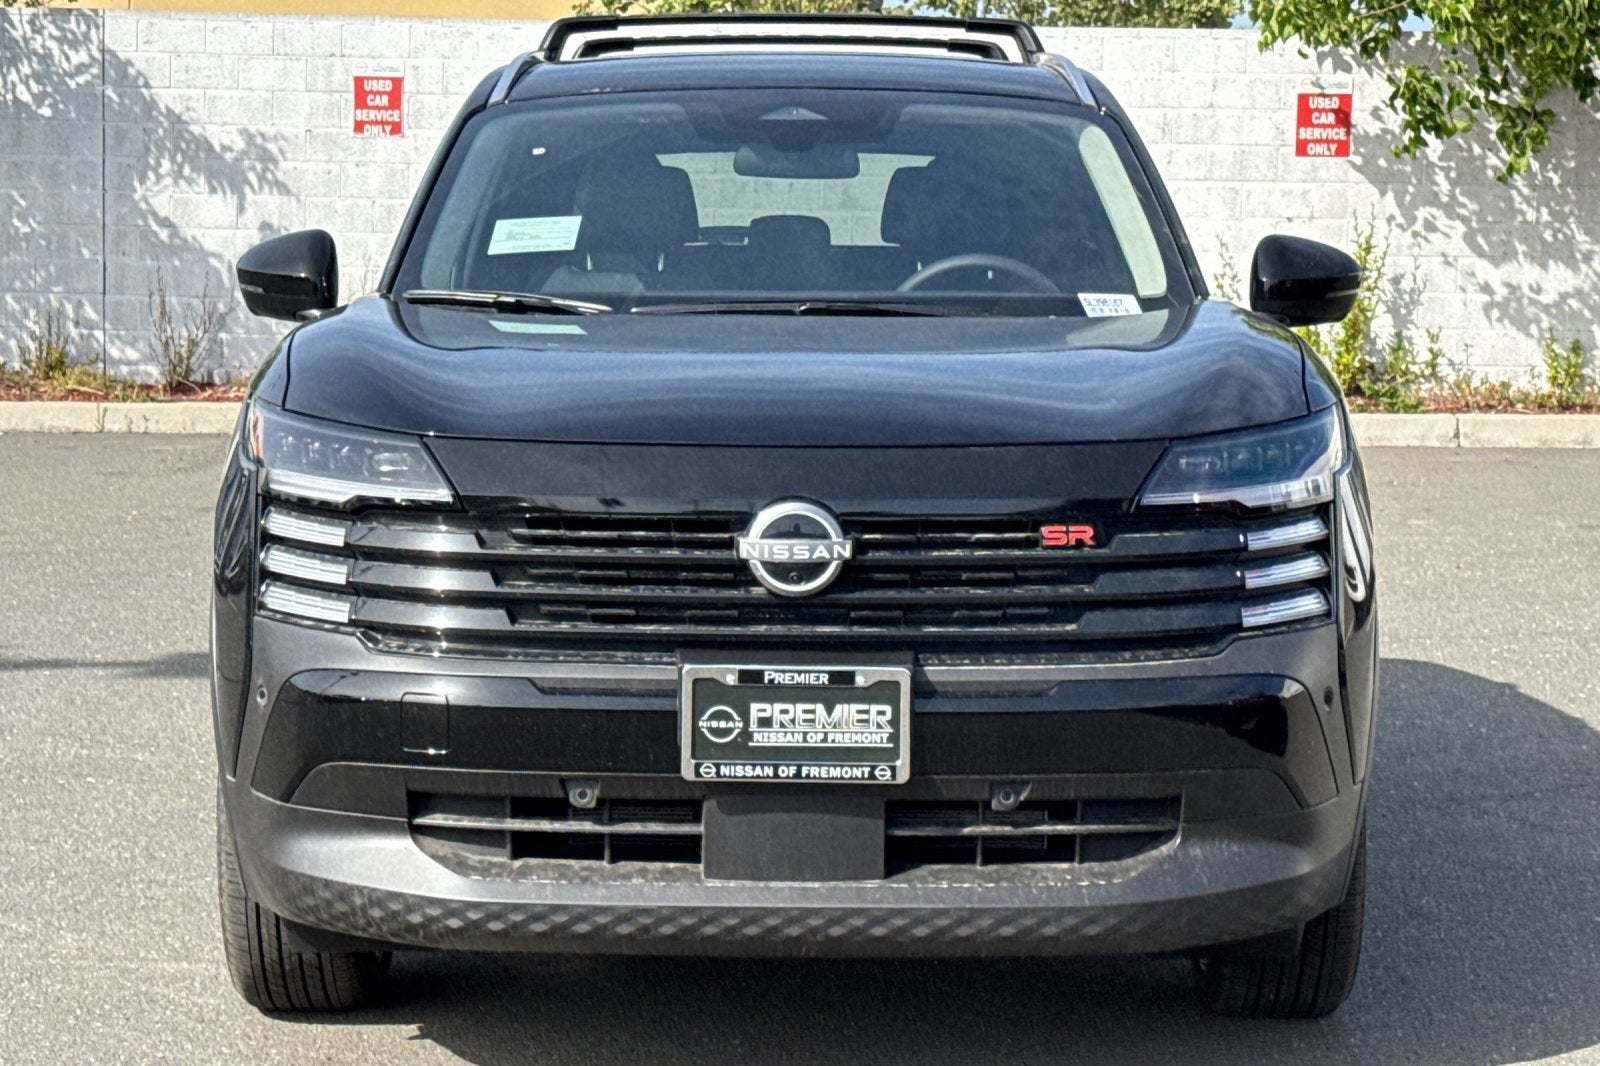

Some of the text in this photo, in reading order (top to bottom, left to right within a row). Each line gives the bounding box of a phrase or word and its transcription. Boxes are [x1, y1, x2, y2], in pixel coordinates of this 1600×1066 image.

[364, 80, 392, 91] USED
[367, 94, 388, 106] CAR
[1309, 97, 1339, 109] USED
[355, 109, 400, 121] SERVICE
[1312, 112, 1335, 124] CAR
[363, 124, 392, 137] ONLY
[1299, 128, 1347, 140] SERVICE
[1307, 143, 1337, 155] ONLY
[1041, 525, 1095, 545] SR
[741, 543, 851, 559] NISSAN
[764, 671, 829, 685] PREMIER
[750, 703, 892, 729] PREMIER
[699, 720, 743, 728] NISSAN
[753, 732, 889, 744] NISSAN OF FREMONT
[720, 765, 773, 777] NISSAN
[778, 766, 797, 777] OF
[801, 766, 871, 778] FREMONT
